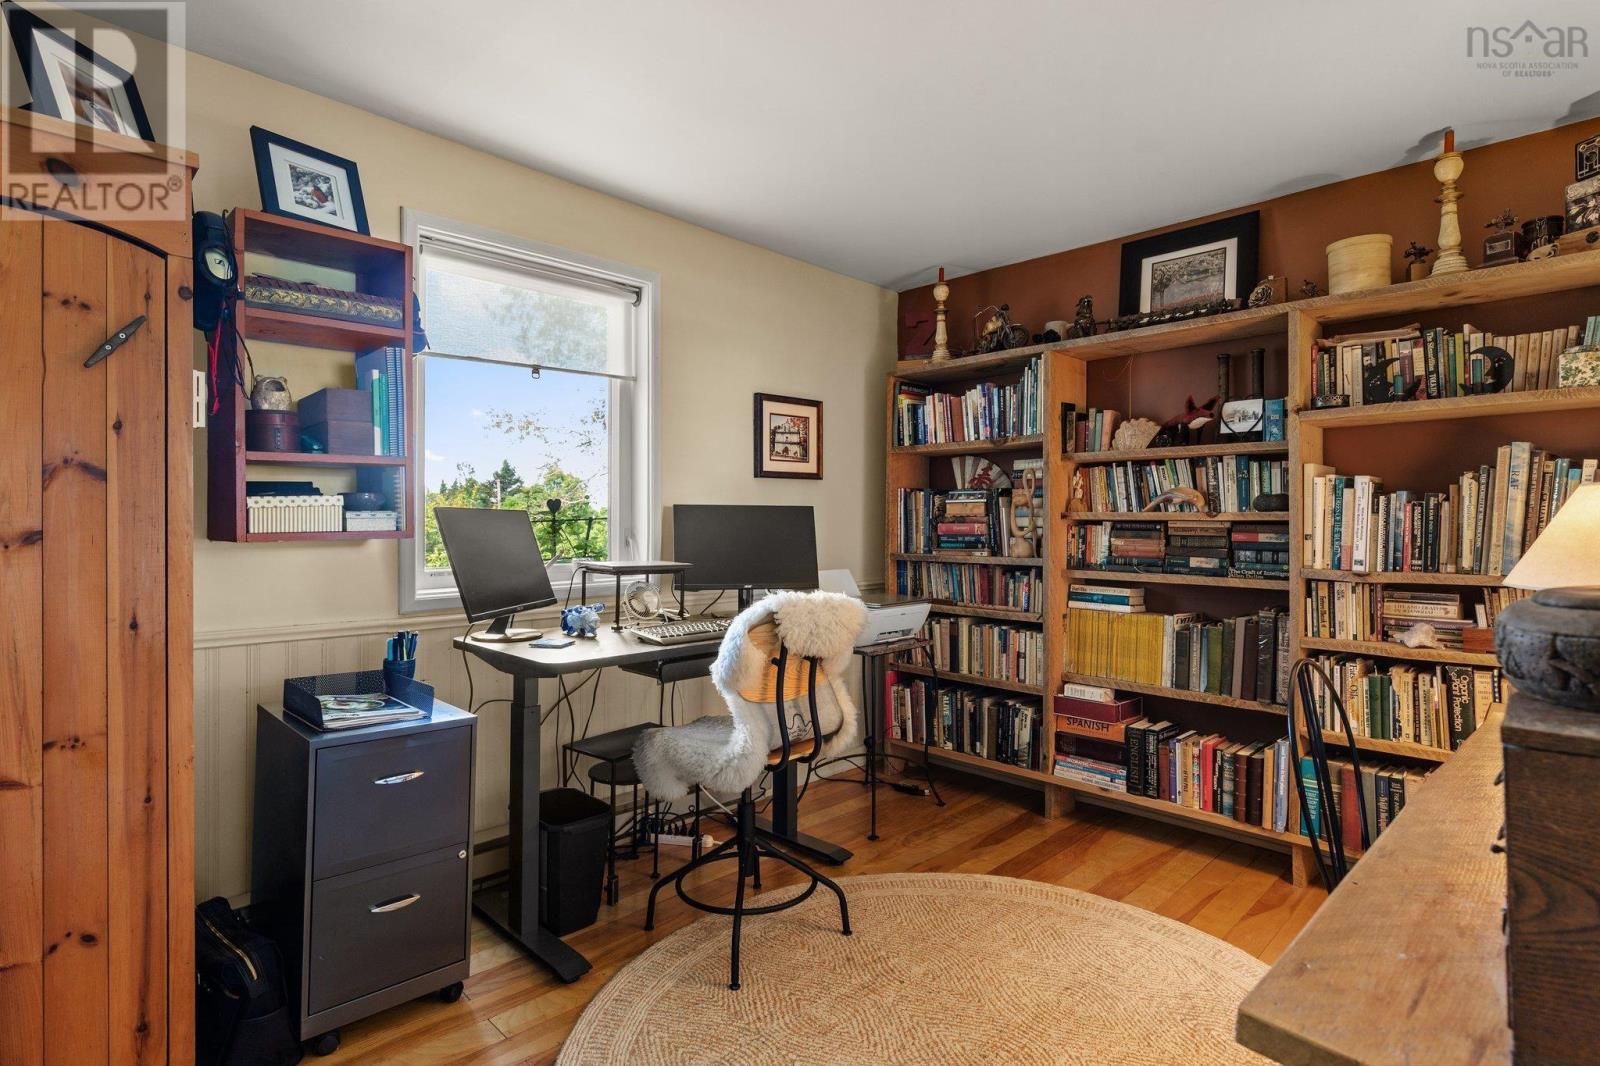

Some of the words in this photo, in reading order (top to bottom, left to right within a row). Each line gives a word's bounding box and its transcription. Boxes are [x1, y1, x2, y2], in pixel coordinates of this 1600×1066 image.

[1511, 470, 1520, 490] RAF
[1350, 685, 1358, 700] Oils
[1452, 678, 1460, 695] Plant
[1460, 676, 1470, 704] Organic
[1067, 717, 1110, 732] SPANISH
[1453, 697, 1462, 732] Protection
[1130, 739, 1139, 783] ENGLISH
